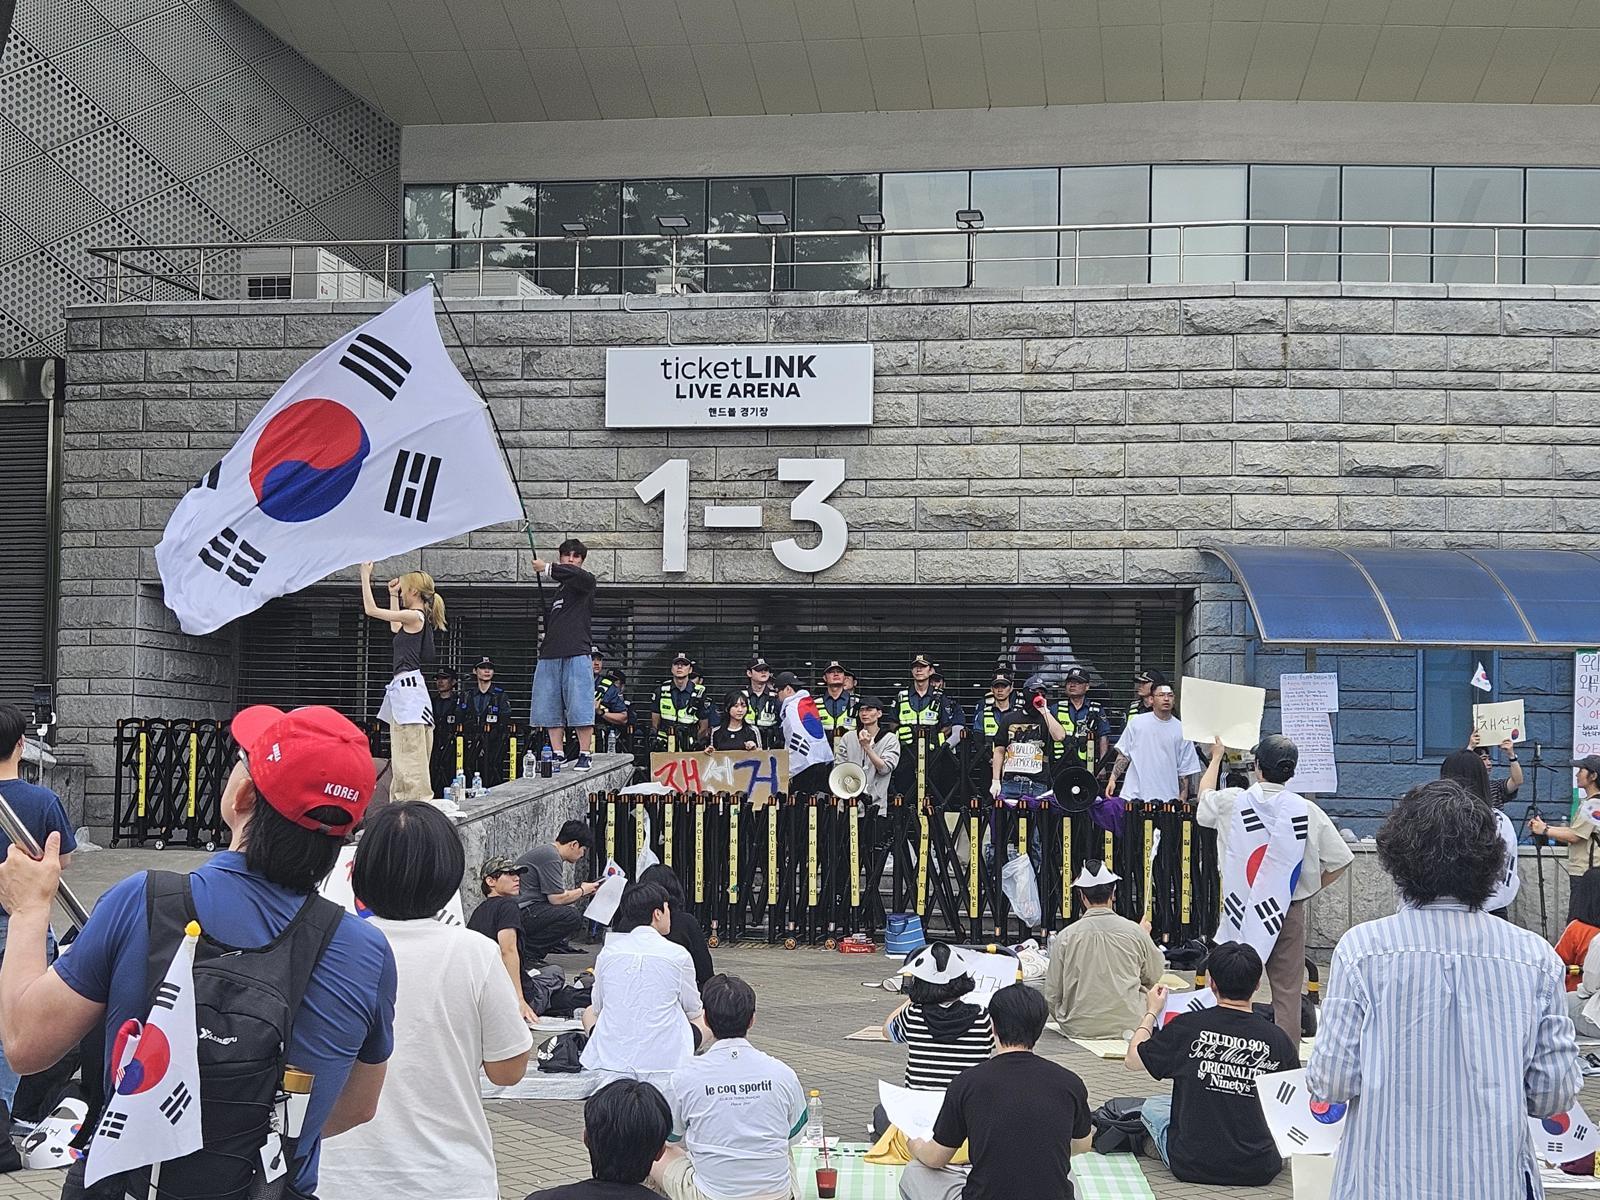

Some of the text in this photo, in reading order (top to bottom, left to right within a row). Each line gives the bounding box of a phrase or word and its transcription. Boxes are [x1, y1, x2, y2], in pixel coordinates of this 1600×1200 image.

[661, 355, 817, 380] ticketLINK
[675, 382, 801, 399] LIVE ARENA
[708, 406, 769, 418] 핸드볼 경기장
[634, 458, 849, 573] 1-3
[1480, 715, 1520, 731] 재선거
[324, 783, 360, 802] KOREA
[1199, 1030, 1270, 1054] STUDIO 90's
[1213, 1046, 1247, 1065] Wild
[1247, 1049, 1280, 1072] Spirit
[705, 1080, 772, 1096] le coq sportif
[1209, 1073, 1252, 1094] Ninety's
